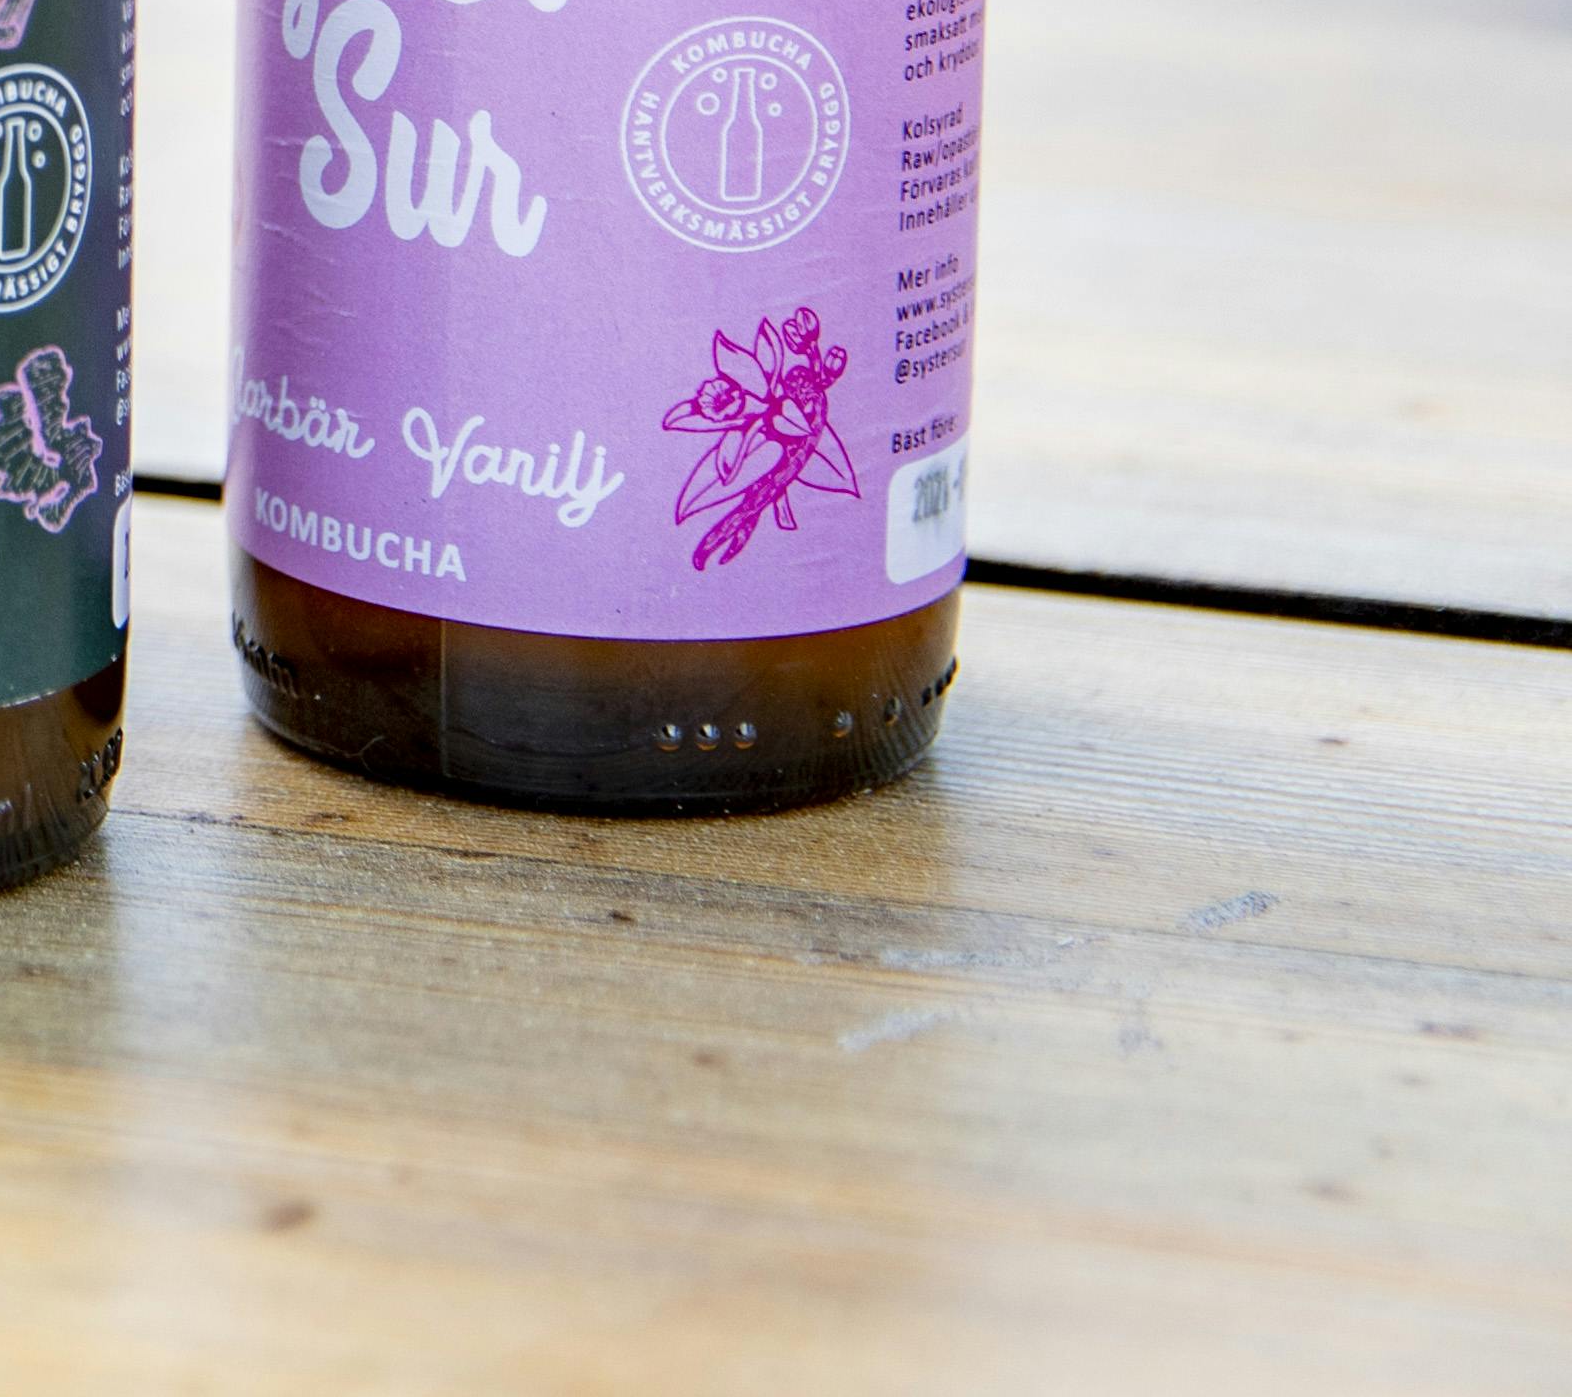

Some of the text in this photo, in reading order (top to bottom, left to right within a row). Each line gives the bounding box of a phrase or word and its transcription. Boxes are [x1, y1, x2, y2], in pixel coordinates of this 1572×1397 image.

[904, 14, 967, 51] smaksatt
[669, 31, 812, 75] KOMBUCHA
[904, 54, 934, 81] och
[903, 102, 964, 141] Kolsyrad
[64, 123, 88, 235] BRYGGD
[633, 81, 841, 241] HANTVERKSMÄSSIGT BRYGGD
[900, 167, 962, 202] Förvaras
[899, 192, 968, 231] Innehåller
[898, 268, 931, 292] Mer
[895, 309, 960, 352] Facebook
[892, 427, 927, 453] Bäst
[402, 406, 625, 528] Vanilj
[254, 486, 467, 583] KOMBUCHA
